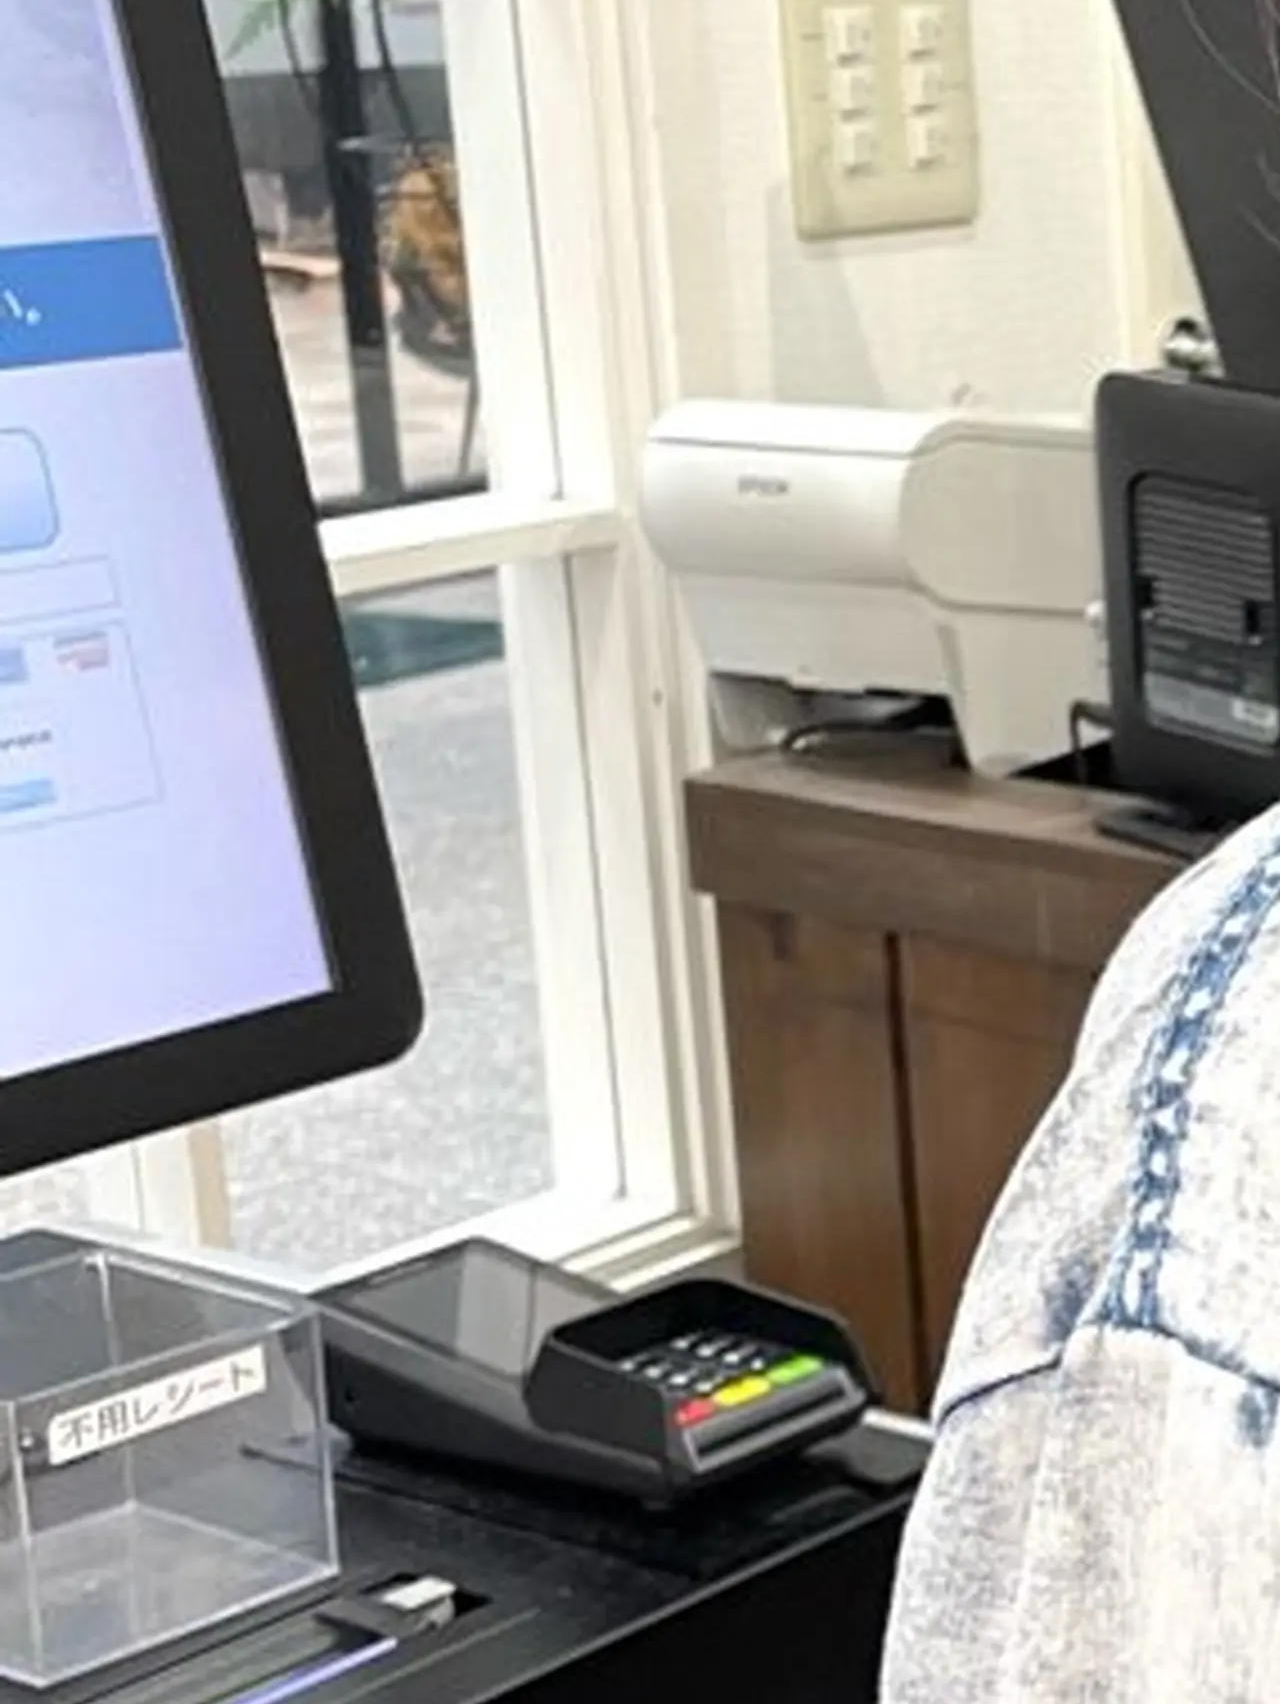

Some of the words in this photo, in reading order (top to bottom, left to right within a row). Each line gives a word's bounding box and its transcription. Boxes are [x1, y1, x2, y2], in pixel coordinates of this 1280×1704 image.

[58, 1361, 255, 1448] 不用レシート
